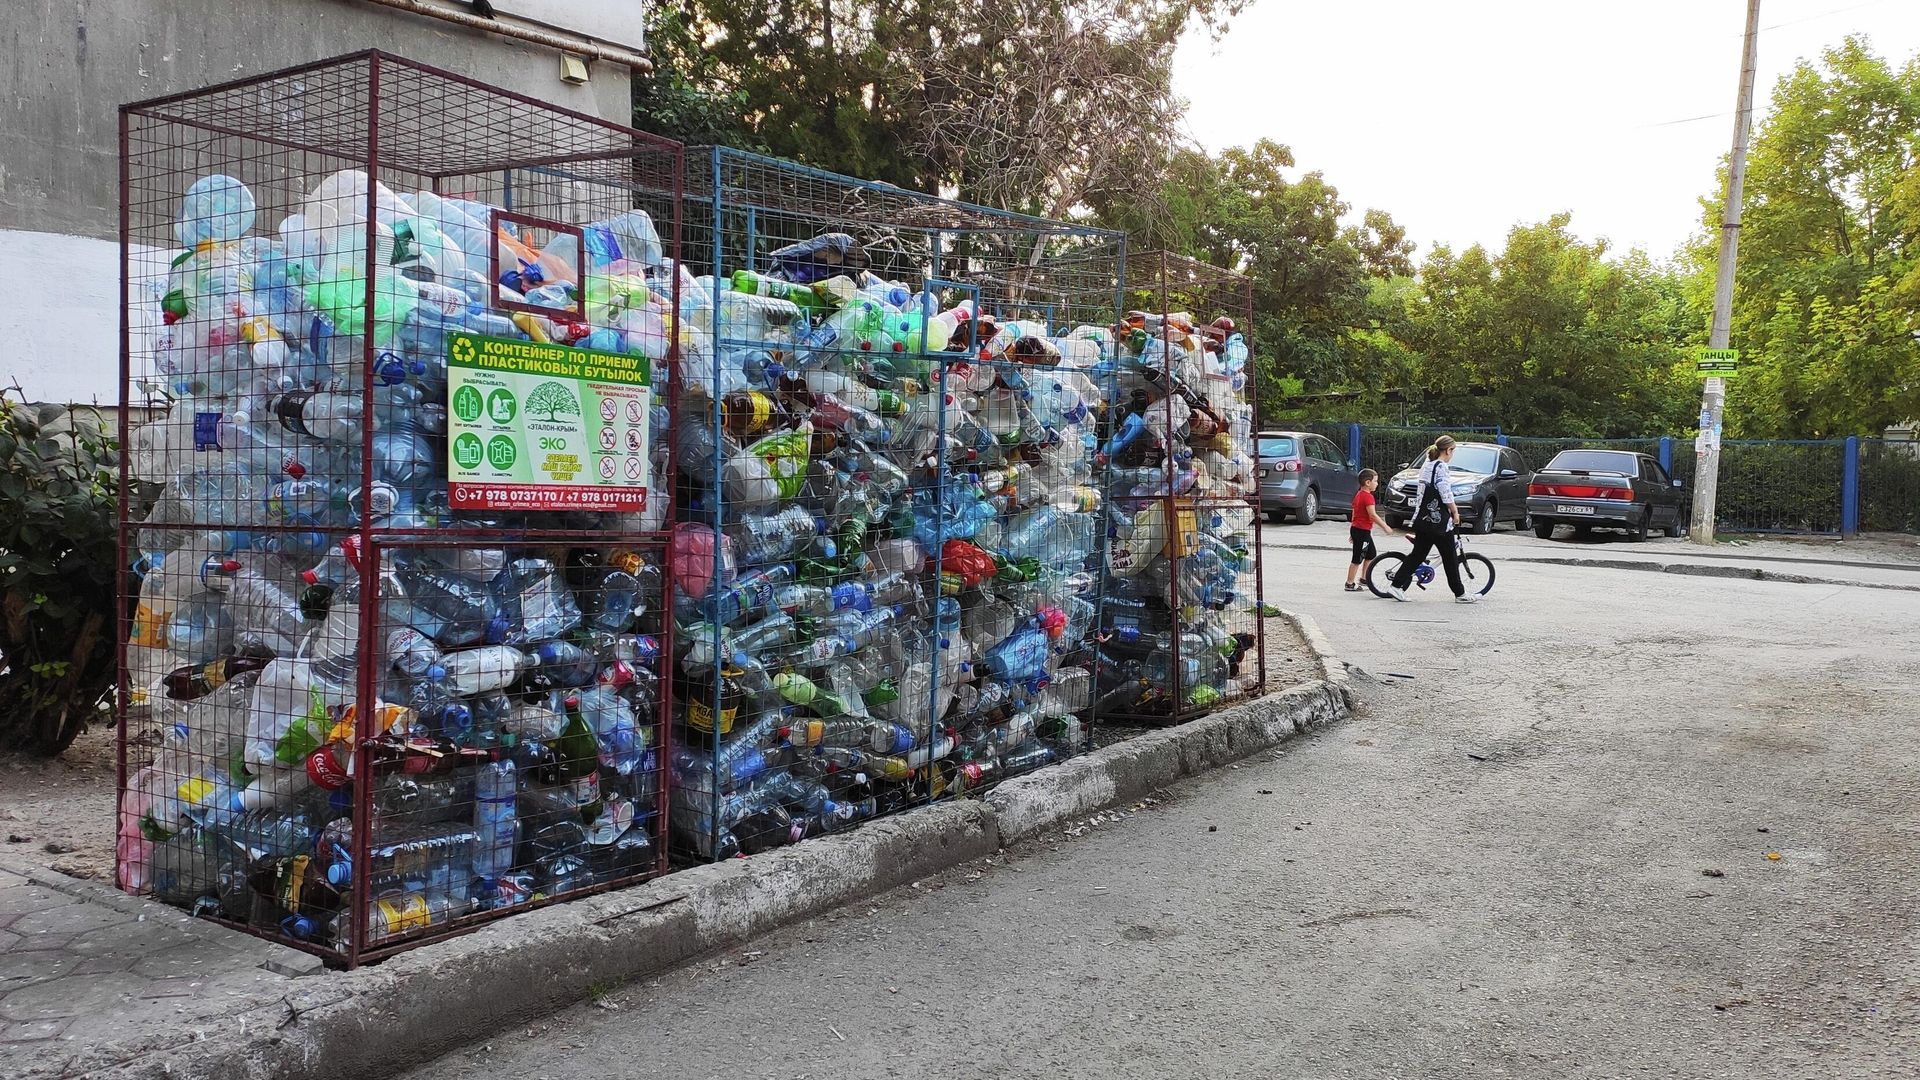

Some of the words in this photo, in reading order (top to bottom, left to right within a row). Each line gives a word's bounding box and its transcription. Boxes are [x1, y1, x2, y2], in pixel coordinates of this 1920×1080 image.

[484, 341, 565, 360] КОНТЕЙНЕР
[569, 352, 586, 363] ПО
[590, 354, 638, 370] ПРИЕМУ
[1699, 351, 1735, 362] ТАНЦЫ
[479, 354, 580, 376] ПЛАСТИКОВЫХ
[585, 366, 642, 382] БУТЫЛОК
[527, 423, 578, 432] «ЭТАЛОН-КРЫМ»
[539, 437, 567, 451] ЭКО
[469, 490, 483, 500] +7
[486, 490, 508, 500] 978
[510, 491, 557, 501] 0737170
[566, 492, 579, 501] +7
[581, 492, 600, 502] 978
[602, 493, 643, 502] 0171211
[696, 704, 714, 719] КВА
